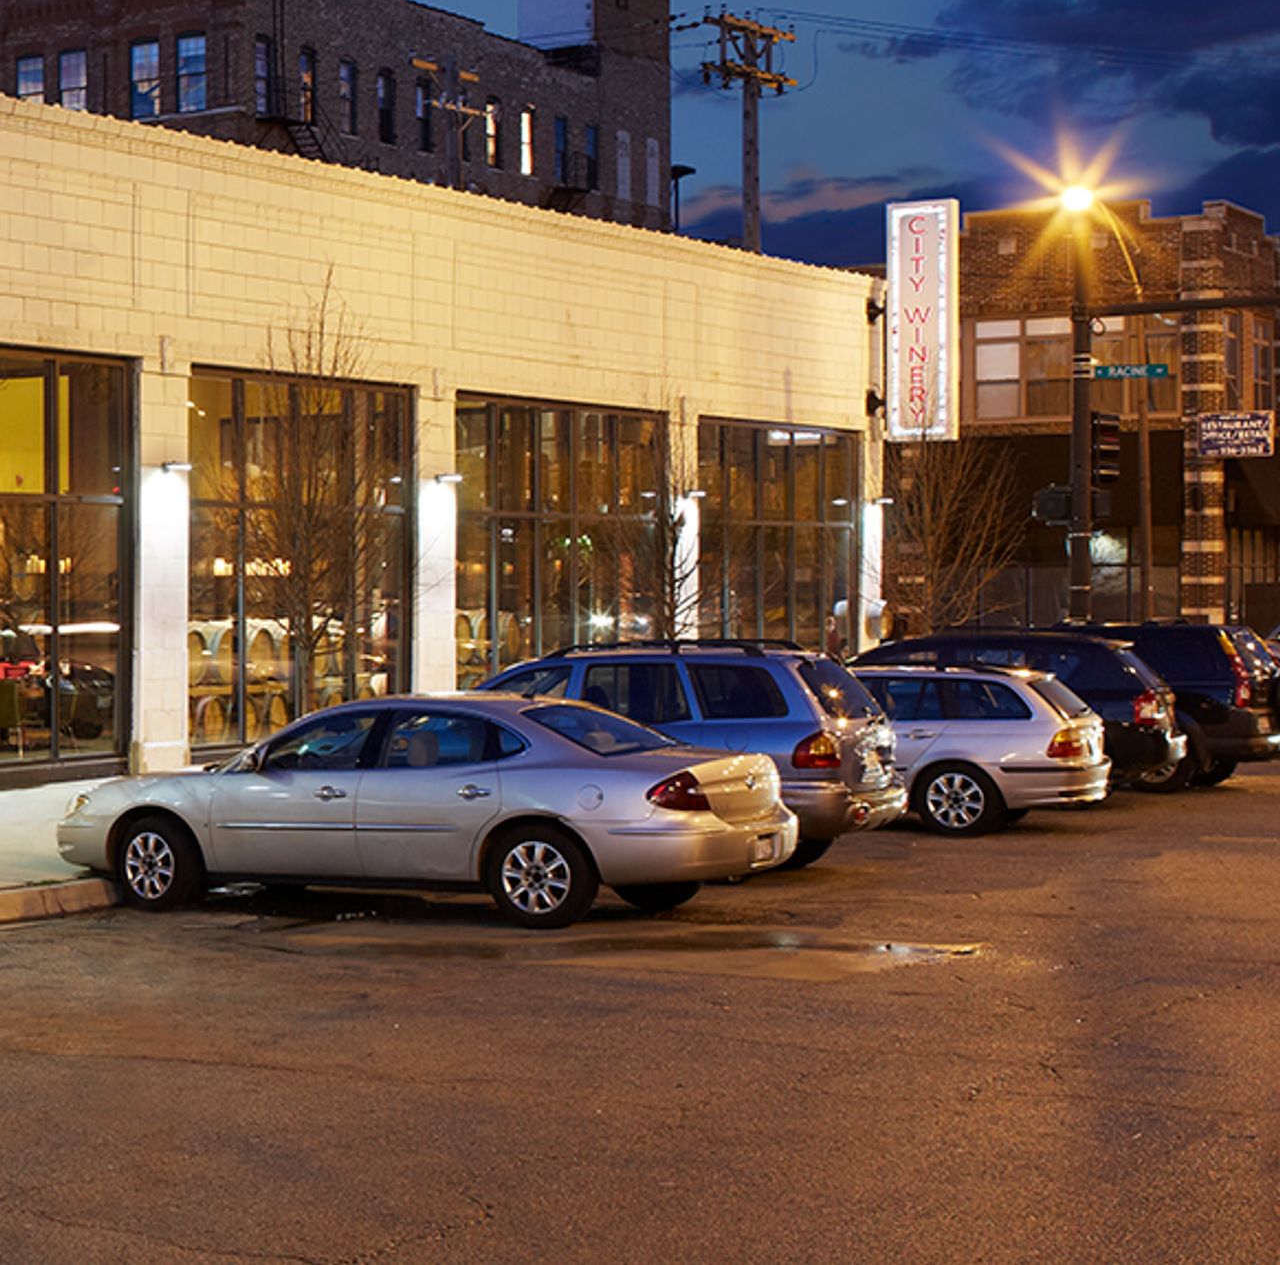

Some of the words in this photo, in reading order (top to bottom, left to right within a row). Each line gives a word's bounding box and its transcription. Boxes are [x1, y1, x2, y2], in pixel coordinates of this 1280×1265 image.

[908, 215, 926, 293] CITY
[904, 306, 931, 423] WINERY
[1108, 365, 1149, 377] RACINE
